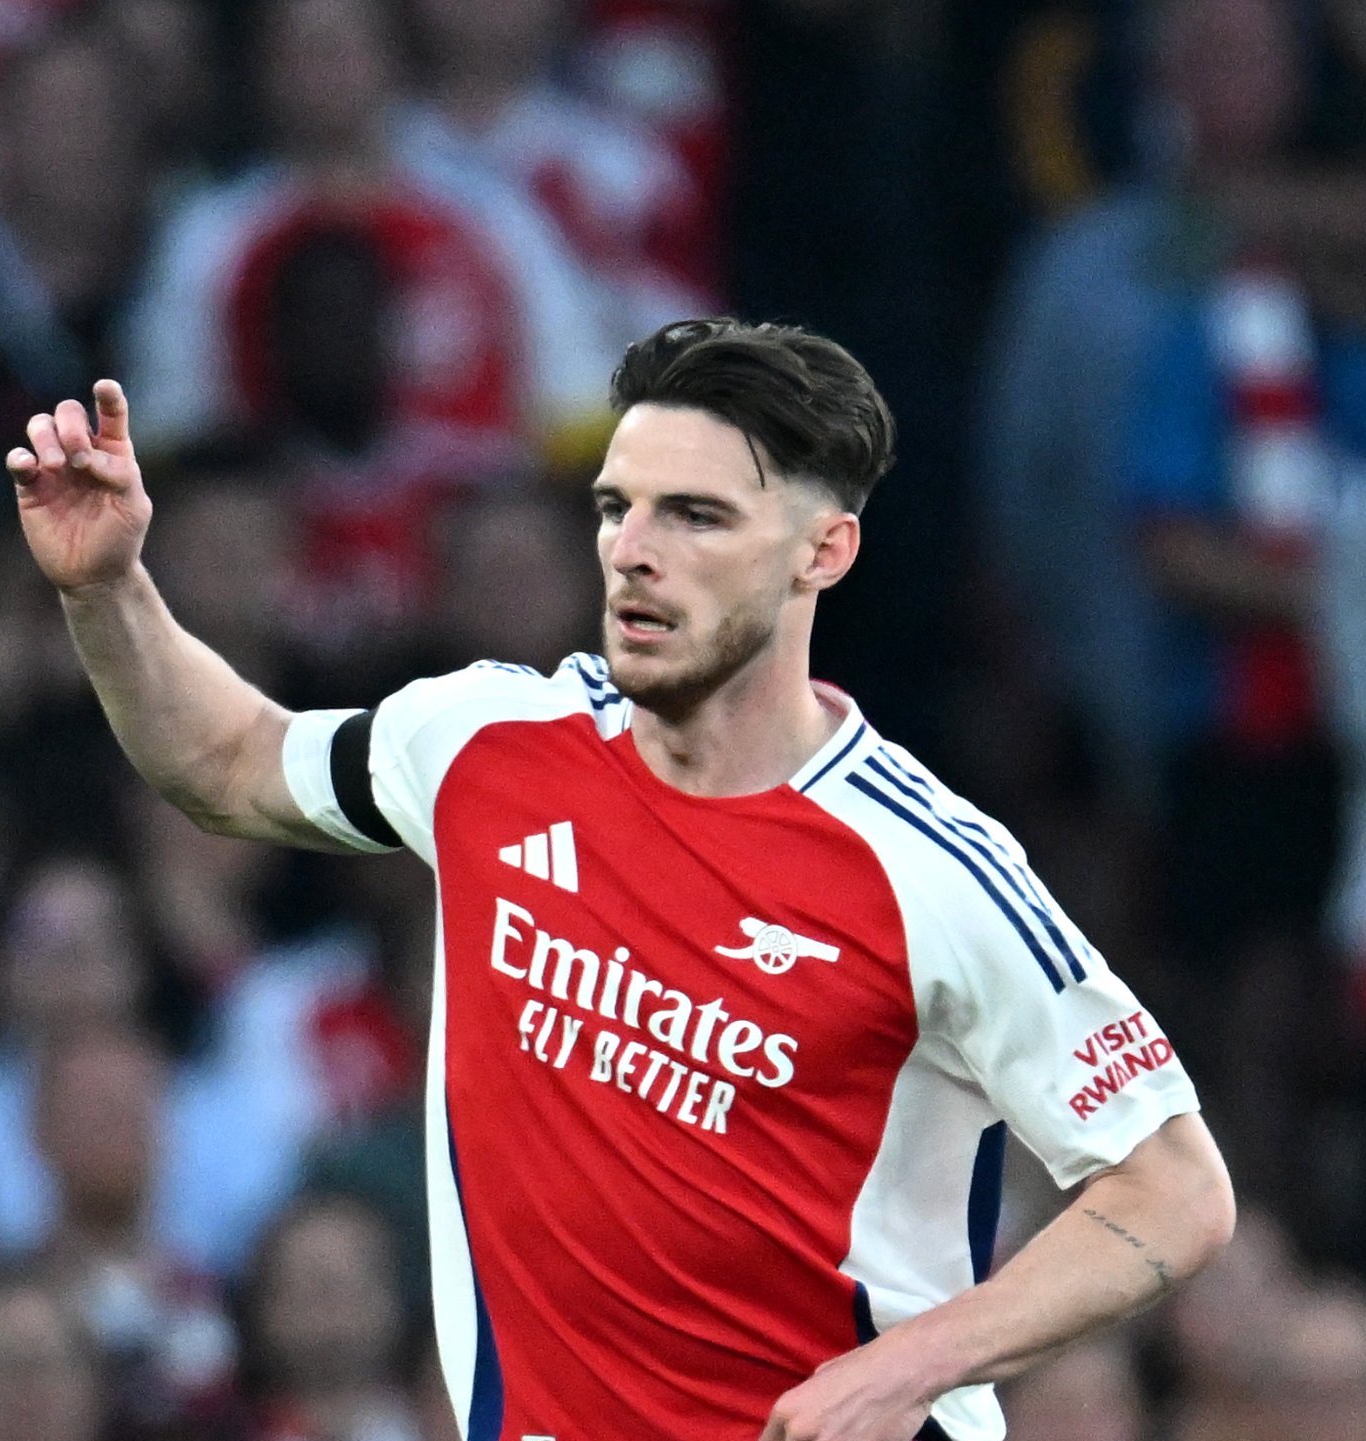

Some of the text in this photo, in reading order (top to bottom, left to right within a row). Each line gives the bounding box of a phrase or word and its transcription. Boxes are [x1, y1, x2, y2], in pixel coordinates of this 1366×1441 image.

[490, 896, 799, 1088] Emirates
[1073, 1011, 1148, 1067] VISIT
[518, 999, 736, 1134] FLY BETTER
[1069, 1037, 1174, 1120] RWAND
